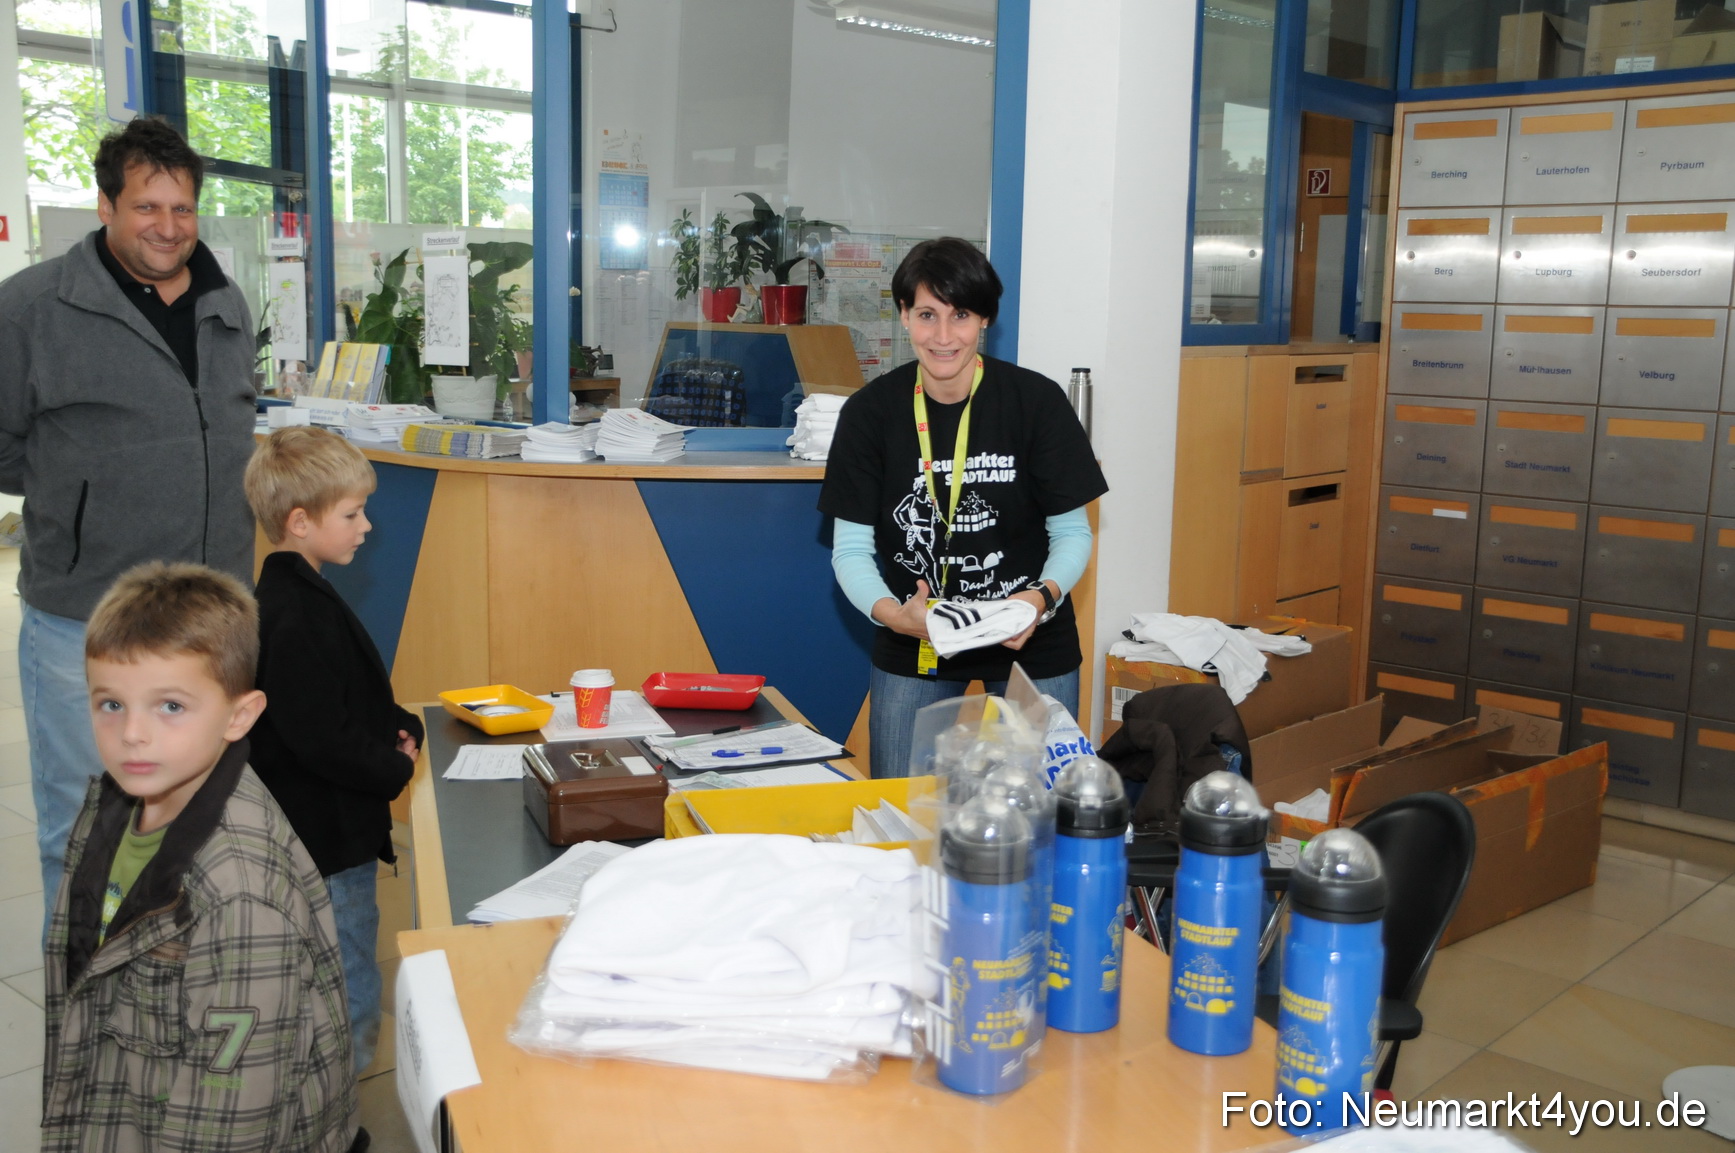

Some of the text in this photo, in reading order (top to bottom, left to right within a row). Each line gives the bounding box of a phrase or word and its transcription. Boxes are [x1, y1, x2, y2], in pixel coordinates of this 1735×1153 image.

[1660, 160, 1705, 170] Pyrbaum
[1431, 171, 1468, 179] Berching
[1535, 166, 1590, 176] Lauterhofen
[1434, 267, 1453, 277] Berg
[1535, 268, 1572, 277] Lupburg
[1641, 268, 1701, 277] Seubersdorf
[1412, 359, 1464, 369] Breitenbrunn
[1519, 365, 1572, 375] Mühlhausen
[1638, 370, 1675, 381] Velburg
[1416, 453, 1447, 464] Deining
[1505, 460, 1571, 474] Stadt Neumarkt
[945, 469, 1017, 486] SADTLAUF
[1410, 543, 1440, 553] Dietfurt
[1502, 554, 1558, 568] VG Neumarkt
[204, 1007, 260, 1074] 7
